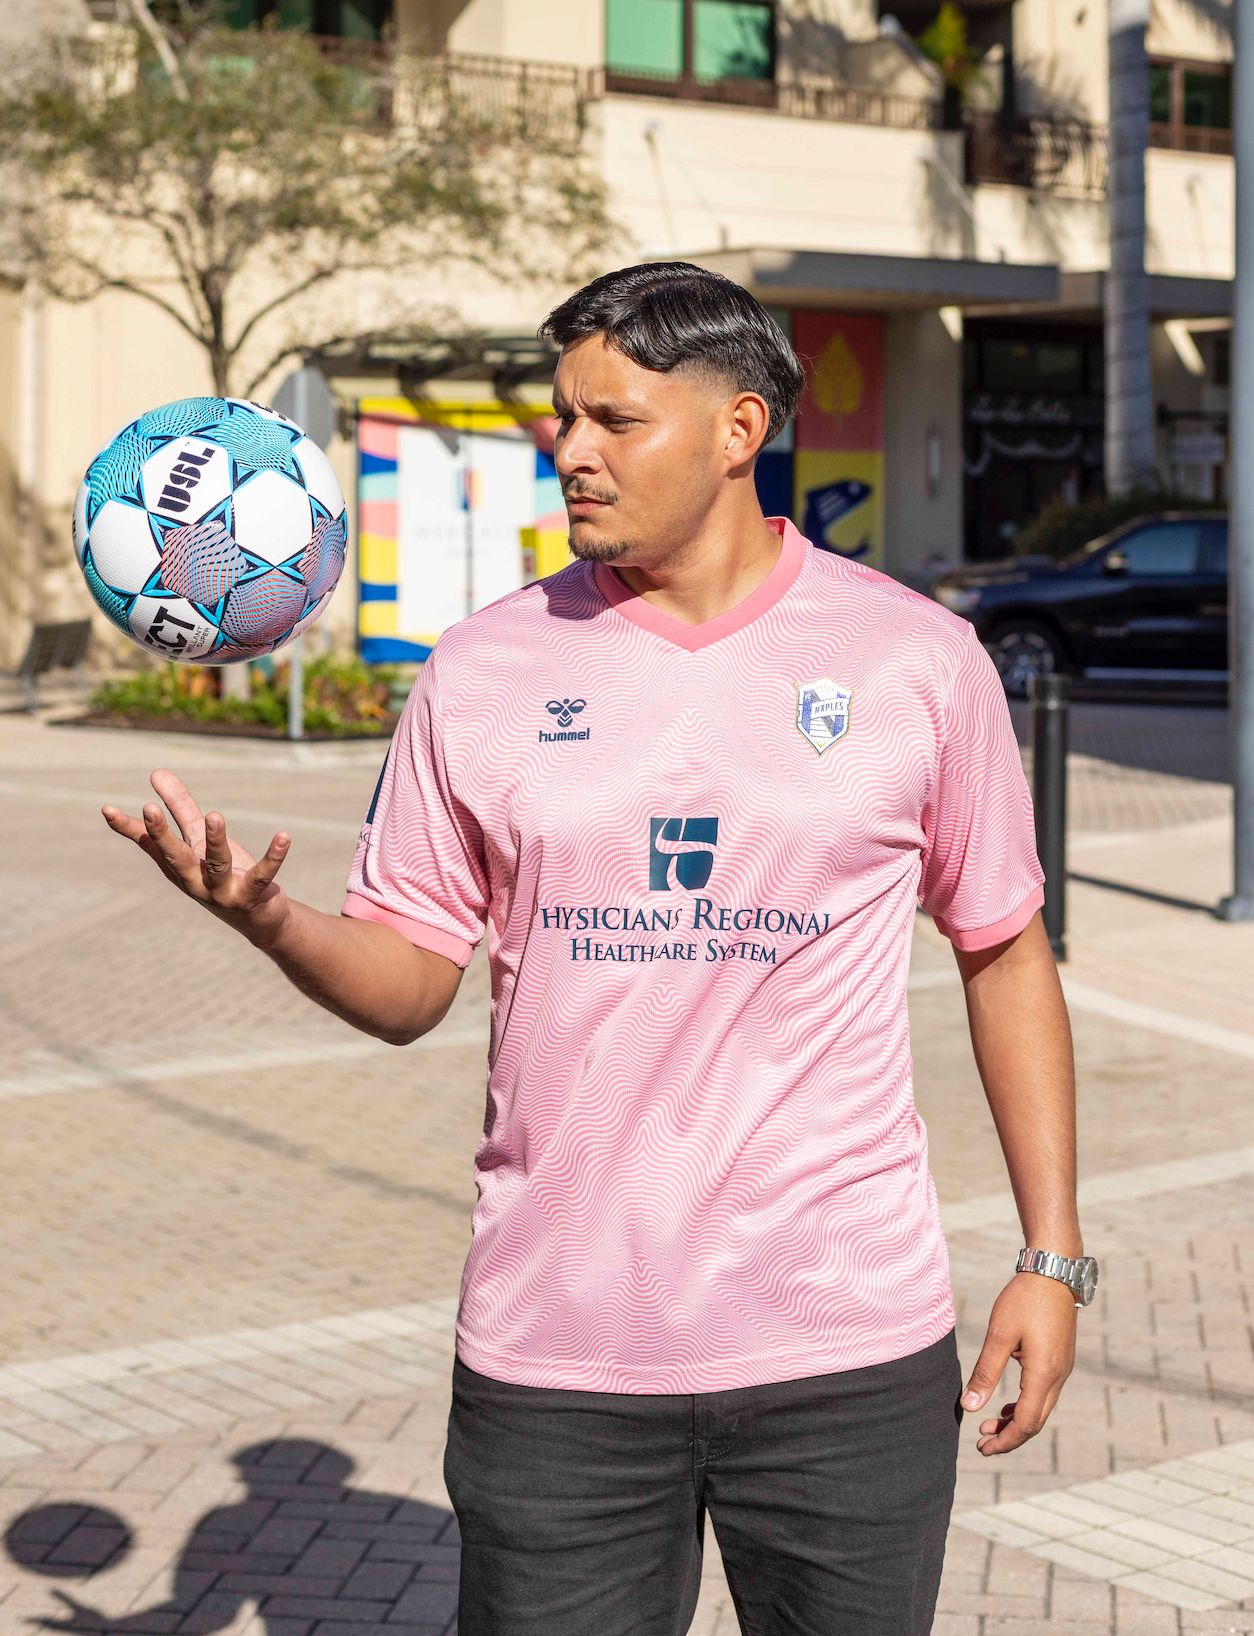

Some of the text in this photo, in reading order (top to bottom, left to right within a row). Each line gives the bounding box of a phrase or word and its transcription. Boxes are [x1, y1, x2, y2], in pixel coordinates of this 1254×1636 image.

[157, 447, 216, 513] USL
[197, 627, 211, 648] SUPER
[815, 701, 844, 714] NAPLES
[538, 727, 590, 743] hummel
[535, 899, 683, 932] HYSICIANS
[706, 938, 777, 965] SYSTEM
